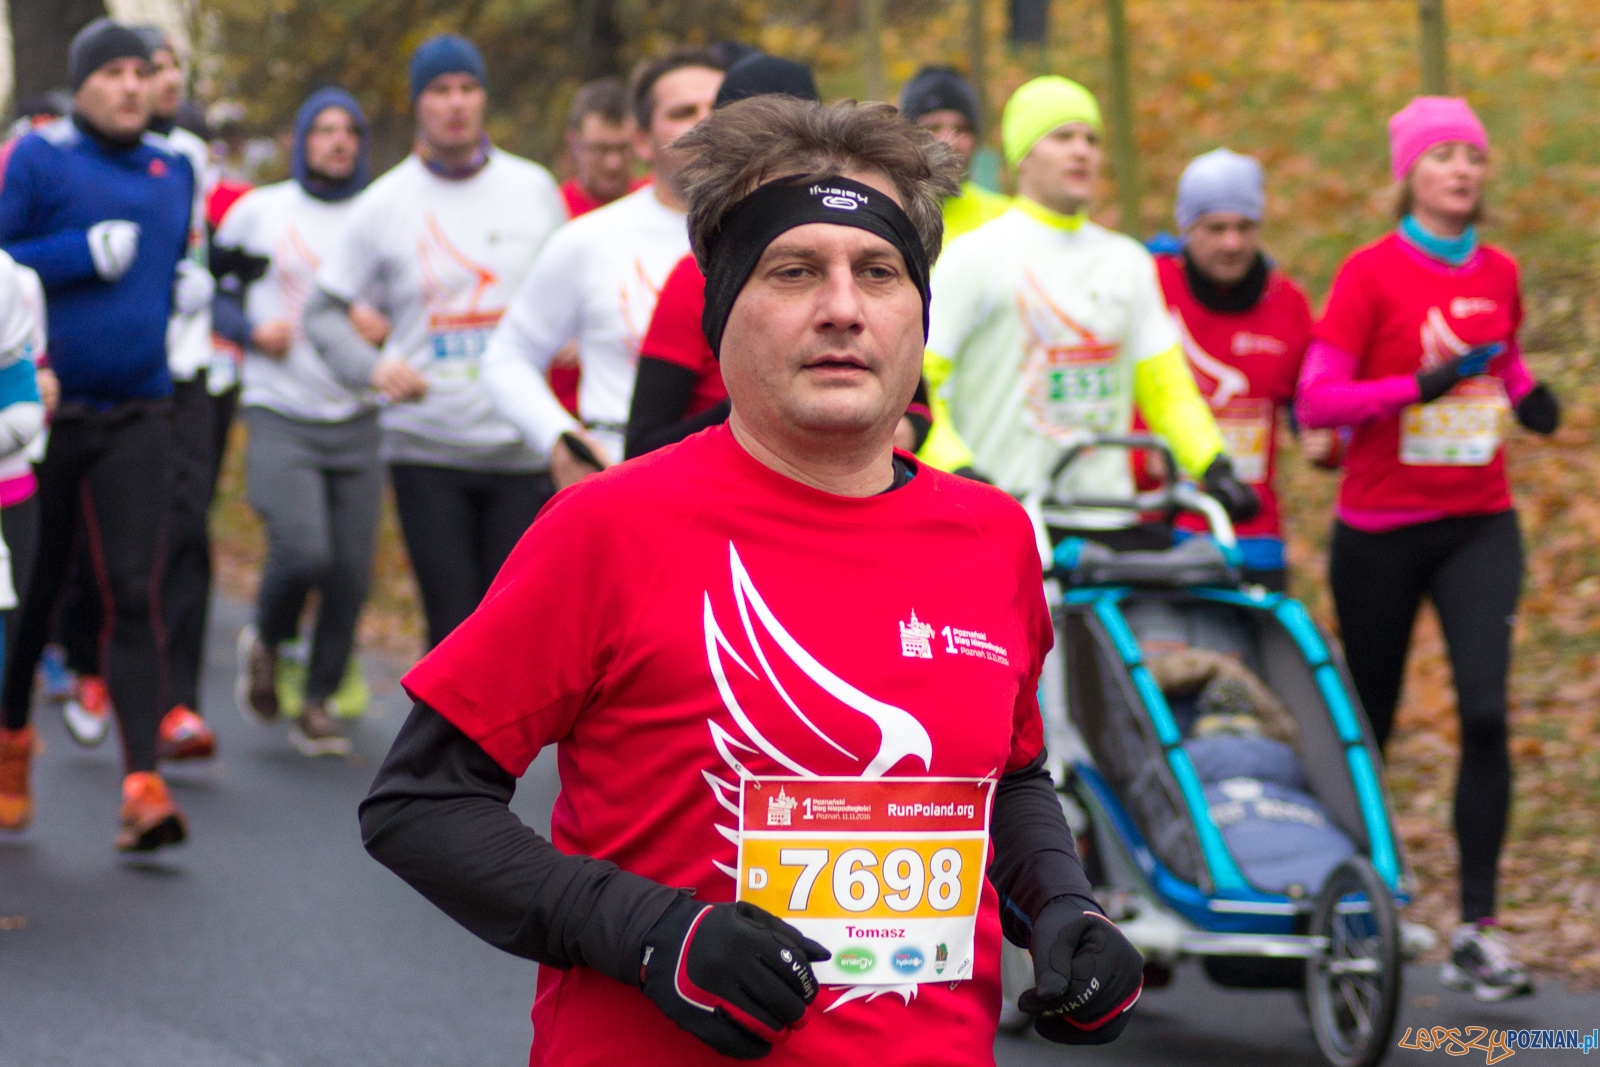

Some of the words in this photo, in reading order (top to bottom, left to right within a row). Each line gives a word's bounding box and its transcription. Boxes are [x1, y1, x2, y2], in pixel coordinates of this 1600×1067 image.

[809, 184, 868, 204] kalenji
[941, 625, 958, 654] 1
[802, 797, 815, 820] 1
[813, 798, 846, 806] Poznański
[813, 805, 827, 813] Bieg
[887, 802, 975, 819] RunPoland.org
[748, 867, 769, 890] D
[780, 848, 963, 912] 7698
[845, 926, 906, 939] Tomasz
[841, 957, 873, 969] energy
[792, 961, 815, 999] viking
[1055, 977, 1100, 1014] viking
